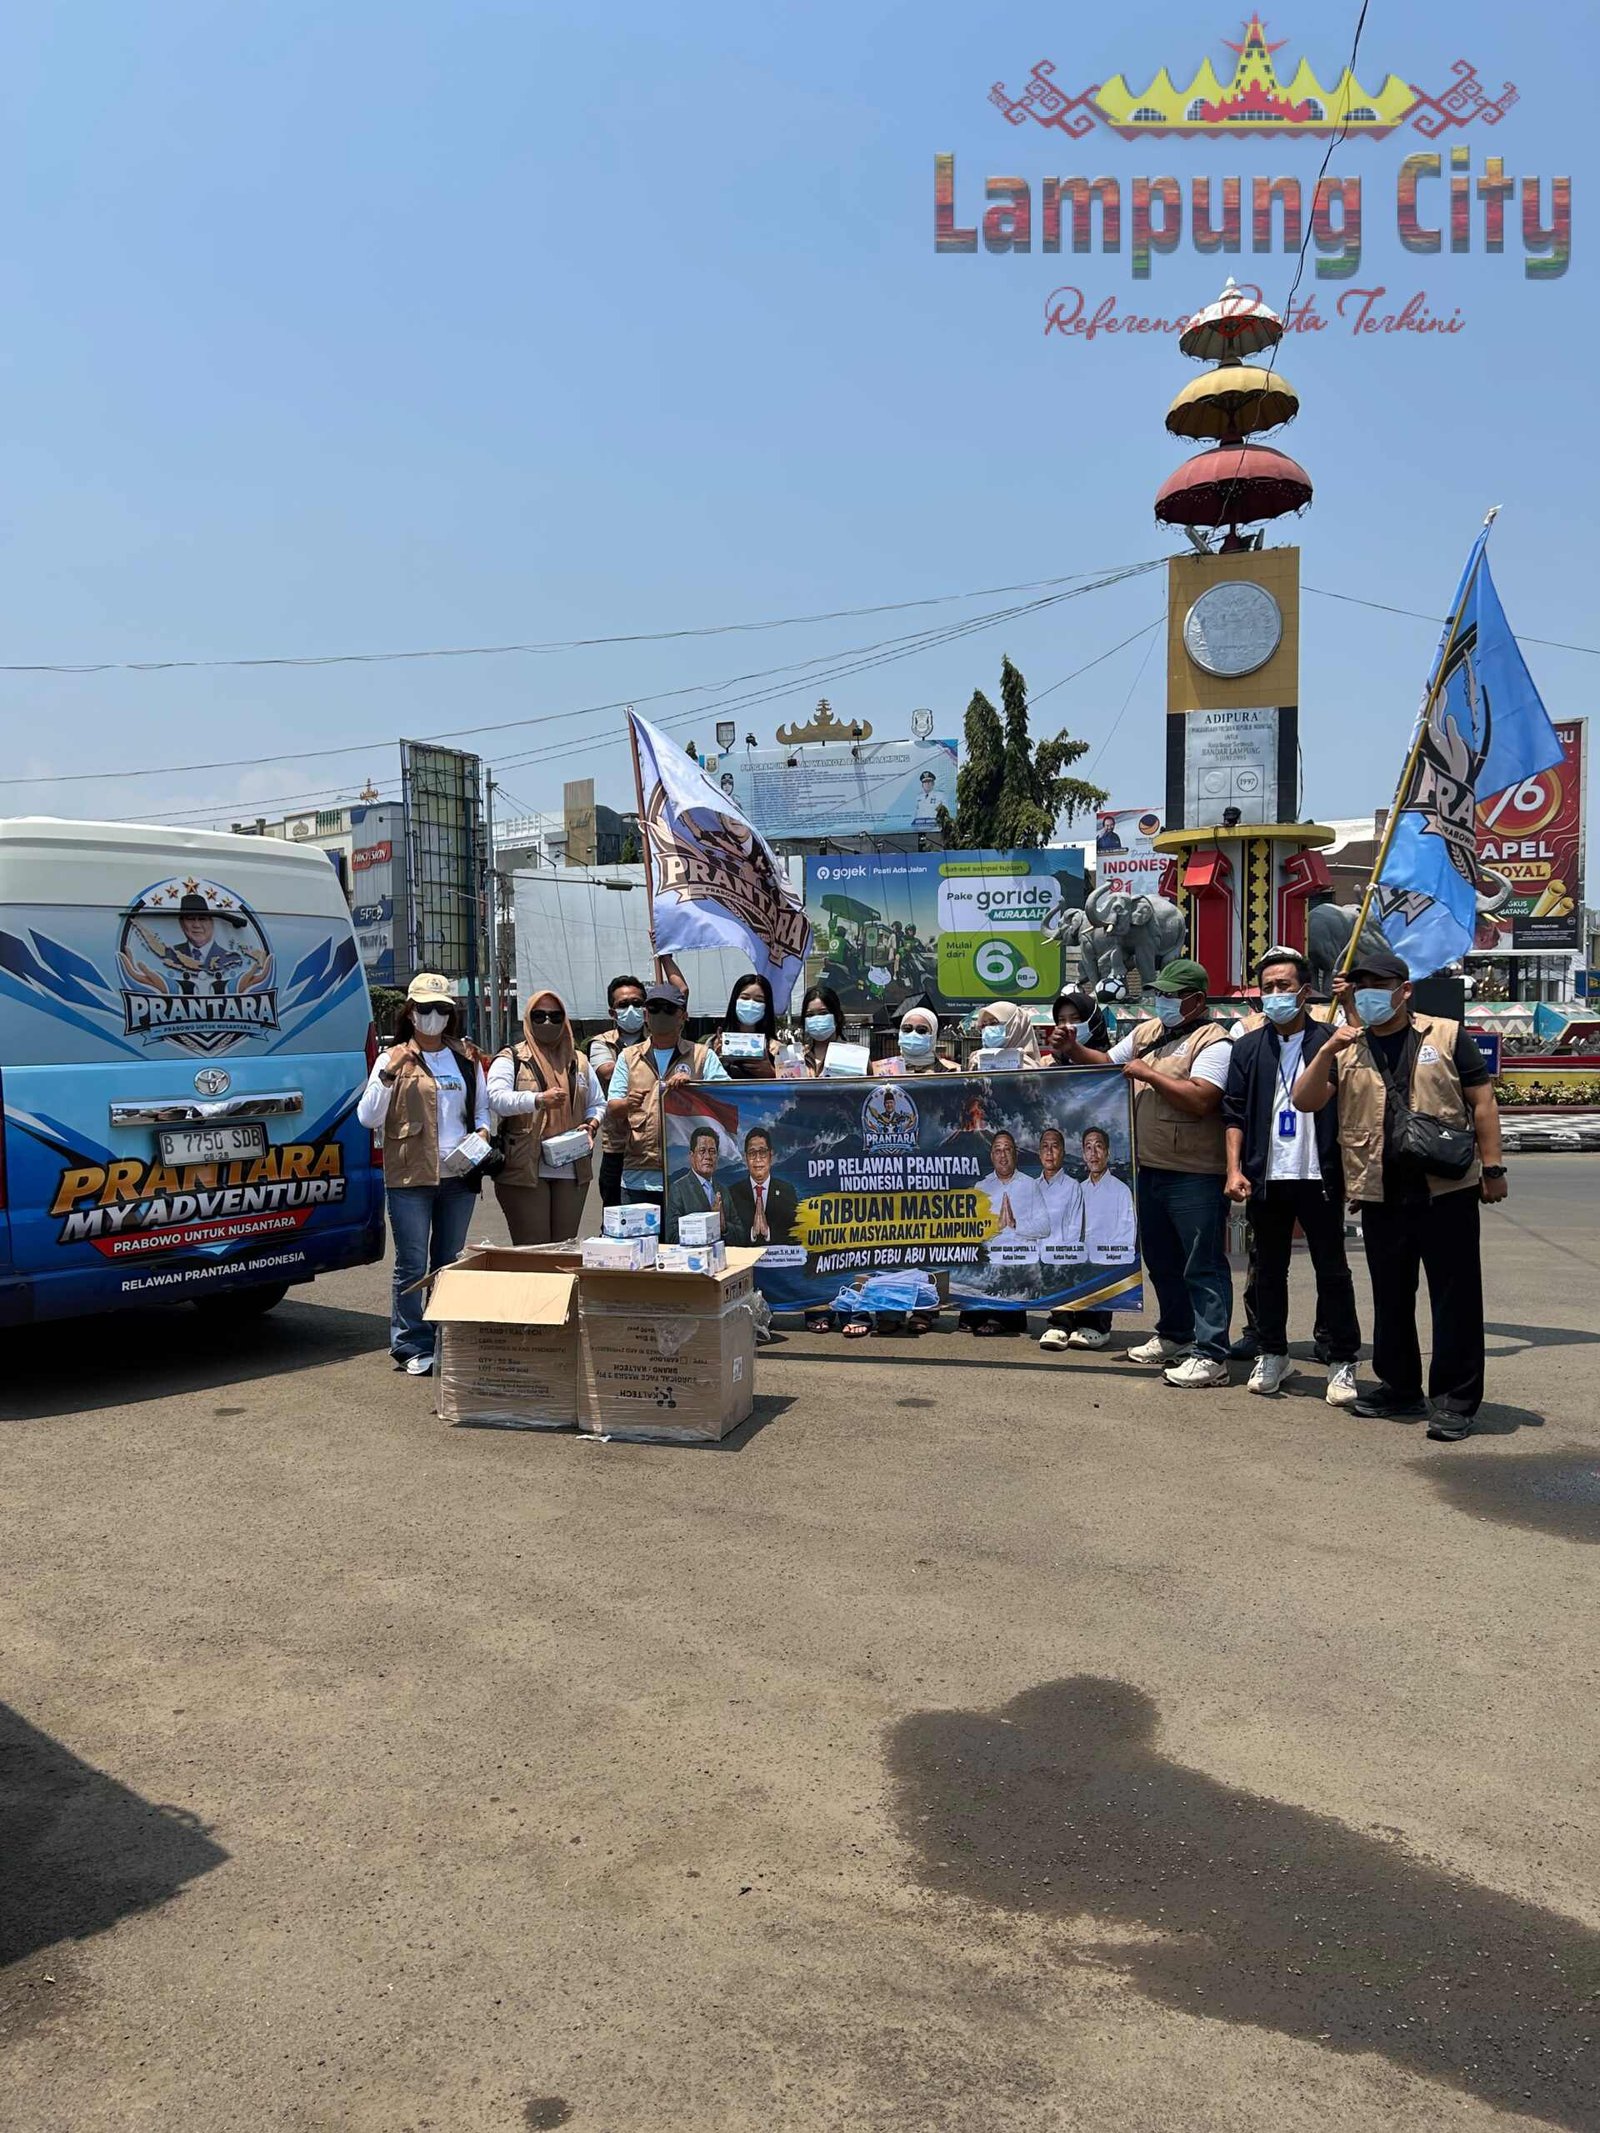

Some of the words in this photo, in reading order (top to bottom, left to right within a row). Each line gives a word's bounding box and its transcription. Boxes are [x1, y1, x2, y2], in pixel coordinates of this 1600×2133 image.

[1558, 730, 1575, 743] RU
[1479, 841, 1555, 860] APEL
[832, 865, 866, 880] gojek
[892, 866, 907, 874] Ada
[1103, 858, 1168, 875] INDONES
[666, 856, 804, 949] PRANTARA
[946, 892, 973, 901] Pake
[976, 886, 1053, 910] goride
[993, 908, 1047, 919] MURAAAH
[946, 941, 972, 950] Mulai
[946, 950, 966, 958] dari
[976, 941, 1014, 982] 6
[129, 994, 276, 1028] PRANTARA
[164, 1136, 175, 1155] B
[184, 1132, 224, 1153] 7750
[232, 1128, 262, 1149] SDB
[866, 1132, 916, 1147] PRANTARA
[808, 1159, 835, 1178] DPP
[838, 1157, 904, 1176] RELAWAN
[907, 1156, 981, 1176] PRANTARA
[840, 1175, 904, 1192] INDONESIA
[907, 1175, 950, 1191] PEDULI
[59, 1202, 137, 1243] MY
[140, 1178, 346, 1228] ADVENTURE
[900, 1193, 978, 1220] MASKER
[113, 1233, 181, 1253] PRABOWO
[184, 1228, 226, 1243] UNTUK
[228, 1216, 297, 1237] NUSANTARA
[807, 1228, 847, 1247] UNTUK
[850, 1223, 927, 1243] MASYARAKAT
[122, 1273, 183, 1292] RELAWAN
[185, 1262, 246, 1281] PRANTARA
[248, 1250, 306, 1270] INDONESIA
[816, 1249, 871, 1274] ANTISIPASI
[873, 1248, 901, 1265] DEBU
[904, 1247, 927, 1264] ABU
[929, 1246, 979, 1263] VULKANIK
[619, 1388, 660, 1401] KALTECH
